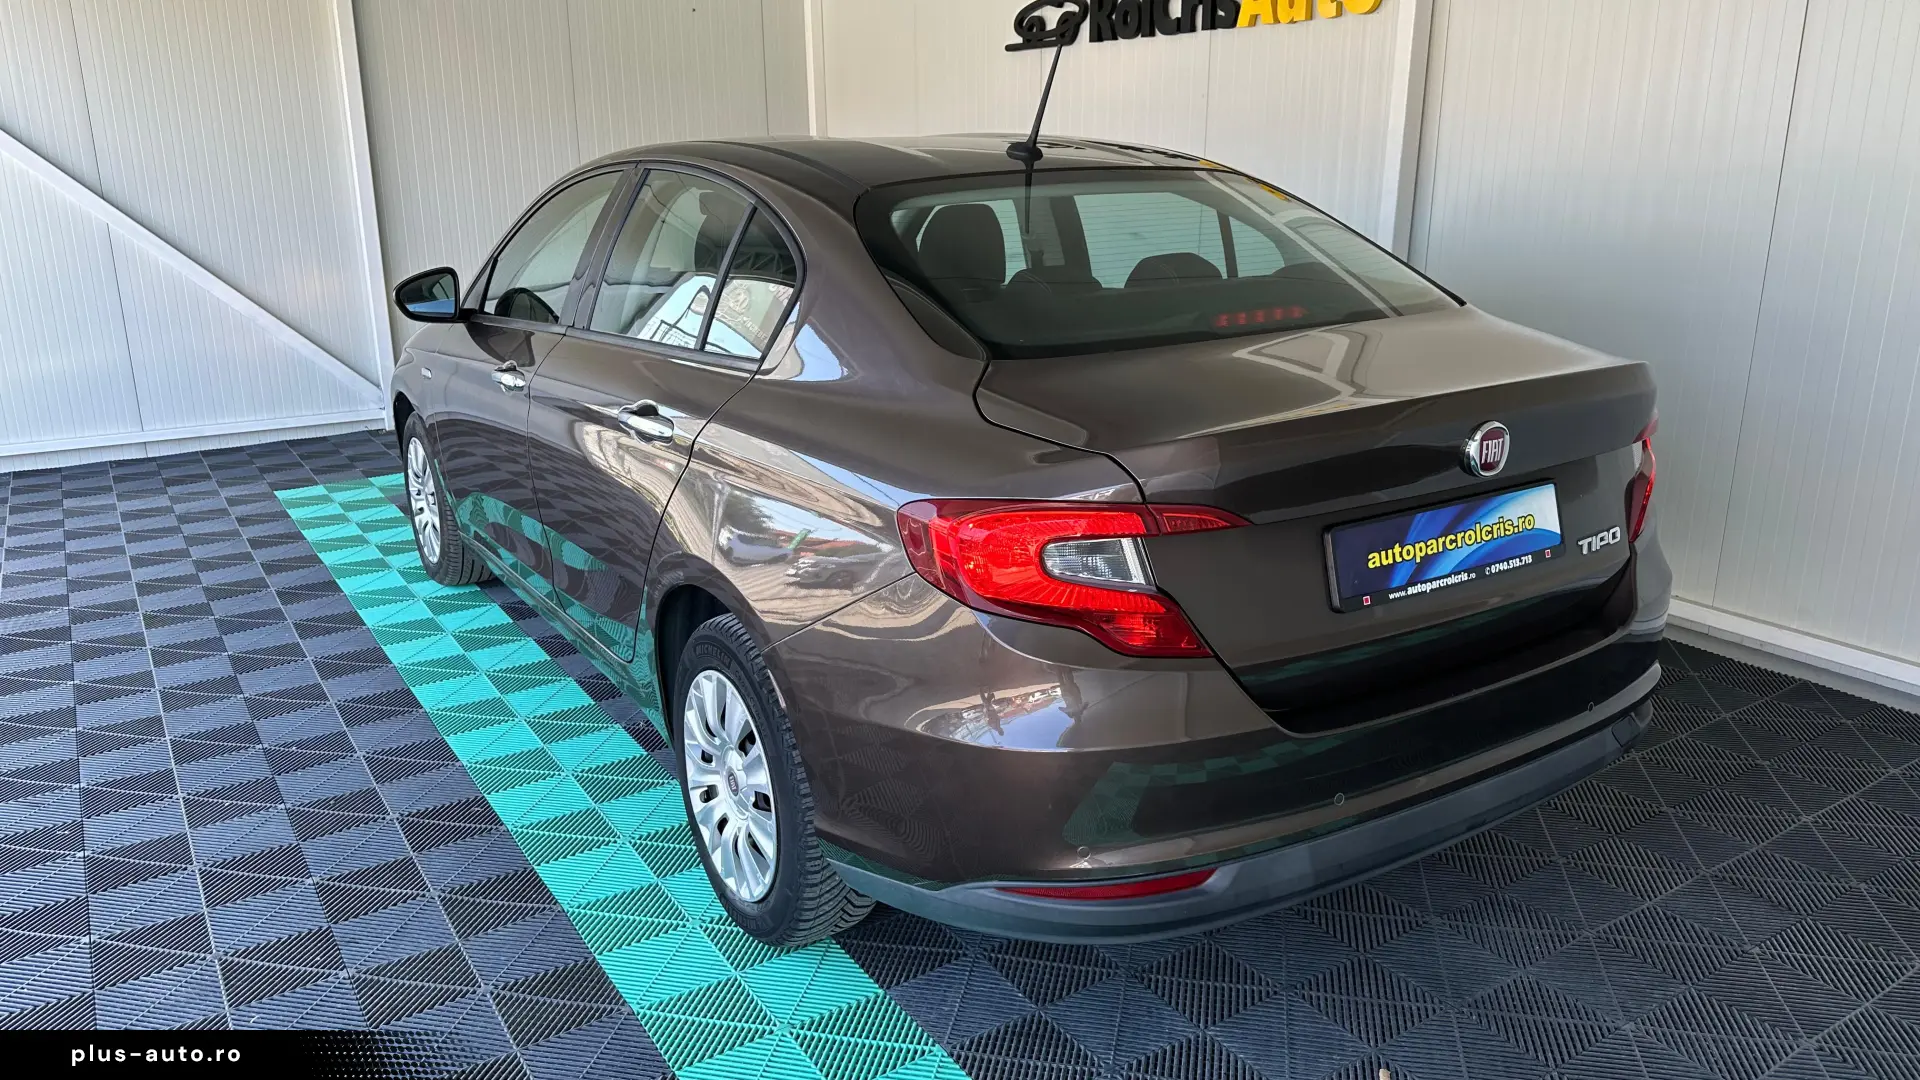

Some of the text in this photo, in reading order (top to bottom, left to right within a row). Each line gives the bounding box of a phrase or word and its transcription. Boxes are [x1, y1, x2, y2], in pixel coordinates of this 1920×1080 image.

[1481, 438, 1504, 464] FIAT
[1367, 513, 1535, 569] autoparcrolcris.ro
[1577, 526, 1621, 555] TIPO
[1490, 554, 1533, 574] 0740.513.713
